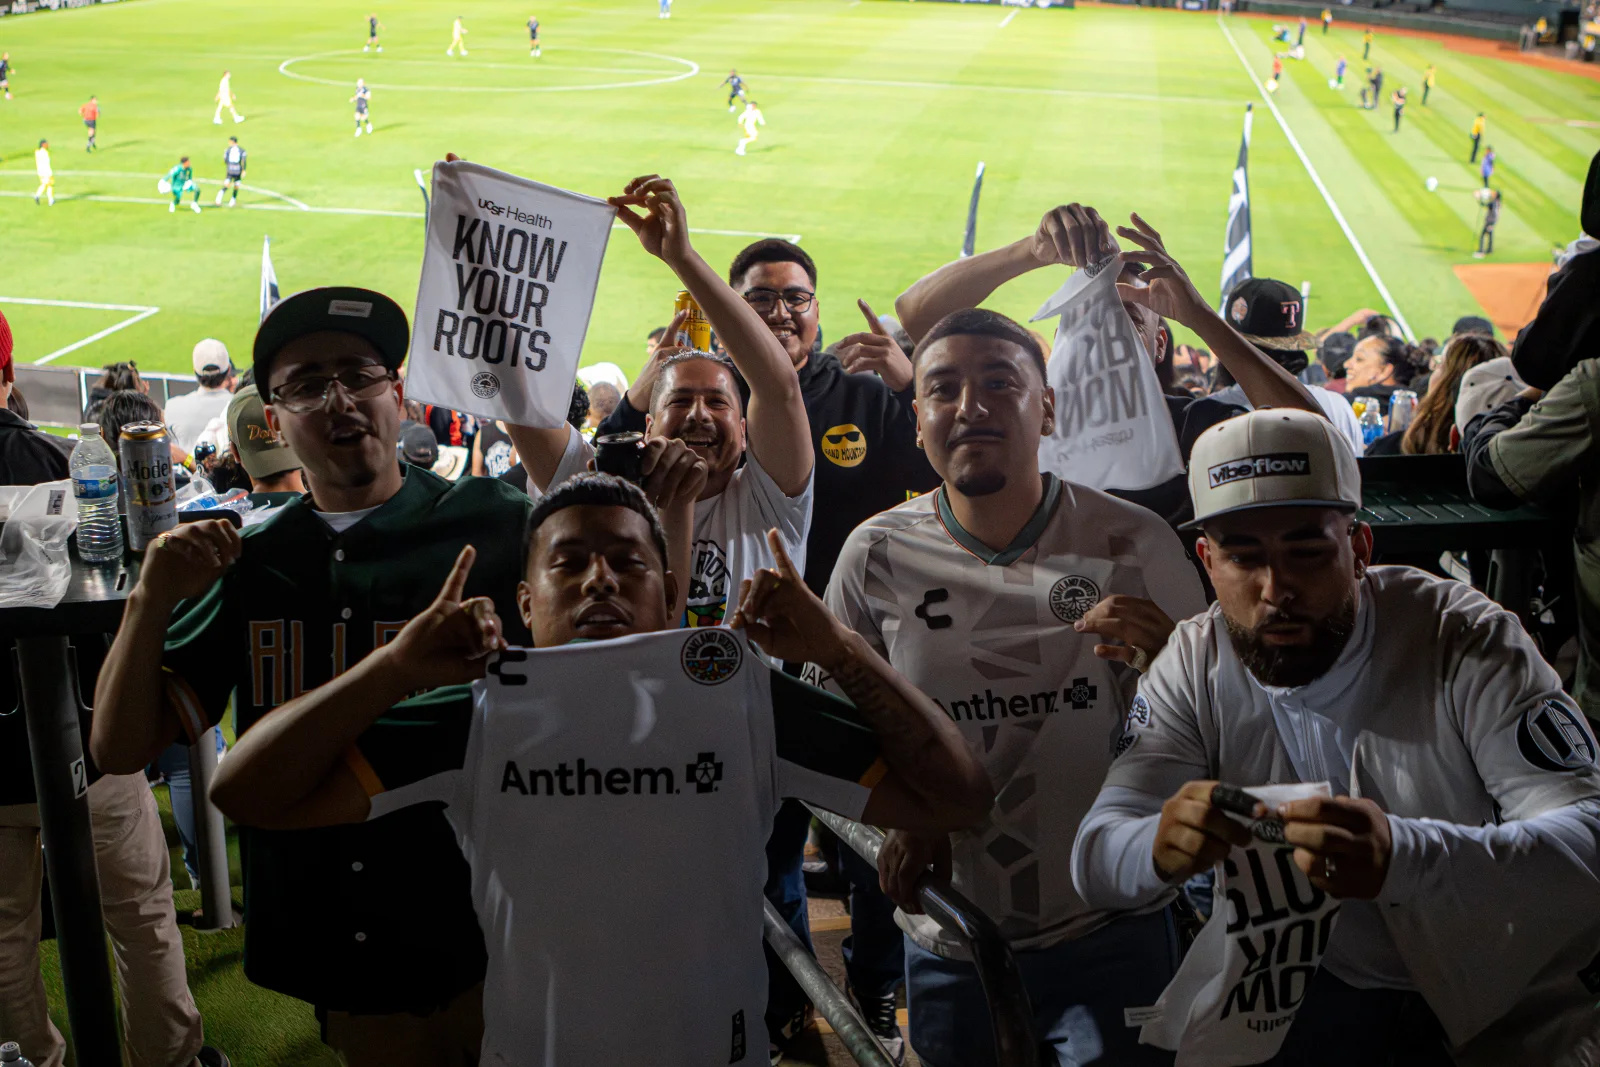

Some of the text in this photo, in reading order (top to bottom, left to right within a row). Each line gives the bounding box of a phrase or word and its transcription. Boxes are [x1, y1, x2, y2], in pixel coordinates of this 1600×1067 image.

[478, 198, 553, 230] UCSF Health
[452, 214, 568, 283] KNOW
[456, 263, 550, 327] YOUR
[1280, 301, 1300, 328] T
[433, 308, 552, 372] ROOTS
[1052, 578, 1079, 602] OAKLAND
[685, 631, 718, 659] OAKLAND
[74, 760, 86, 796] 2
